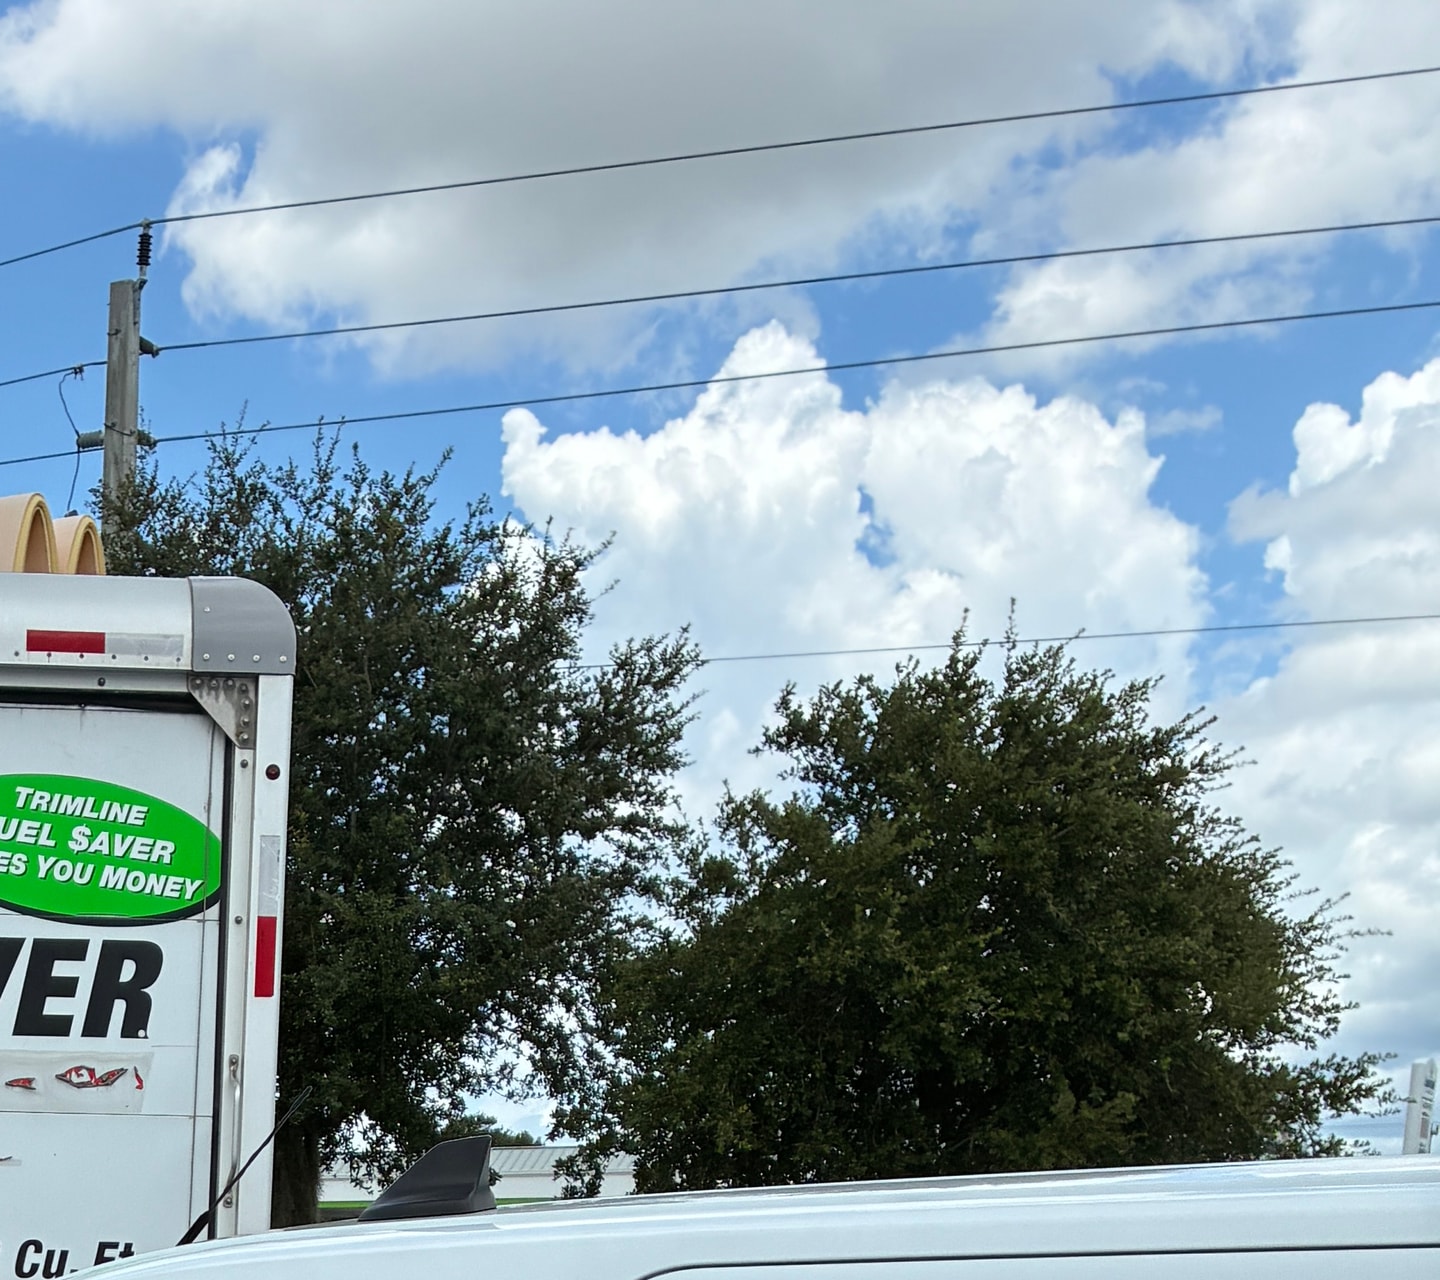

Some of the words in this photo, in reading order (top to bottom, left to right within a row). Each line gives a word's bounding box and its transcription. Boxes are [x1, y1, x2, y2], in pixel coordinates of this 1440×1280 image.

[13, 785, 150, 827] TRIMLINE
[67, 823, 178, 866] $AVER
[36, 855, 96, 887] YOU
[99, 864, 206, 902] MONEY
